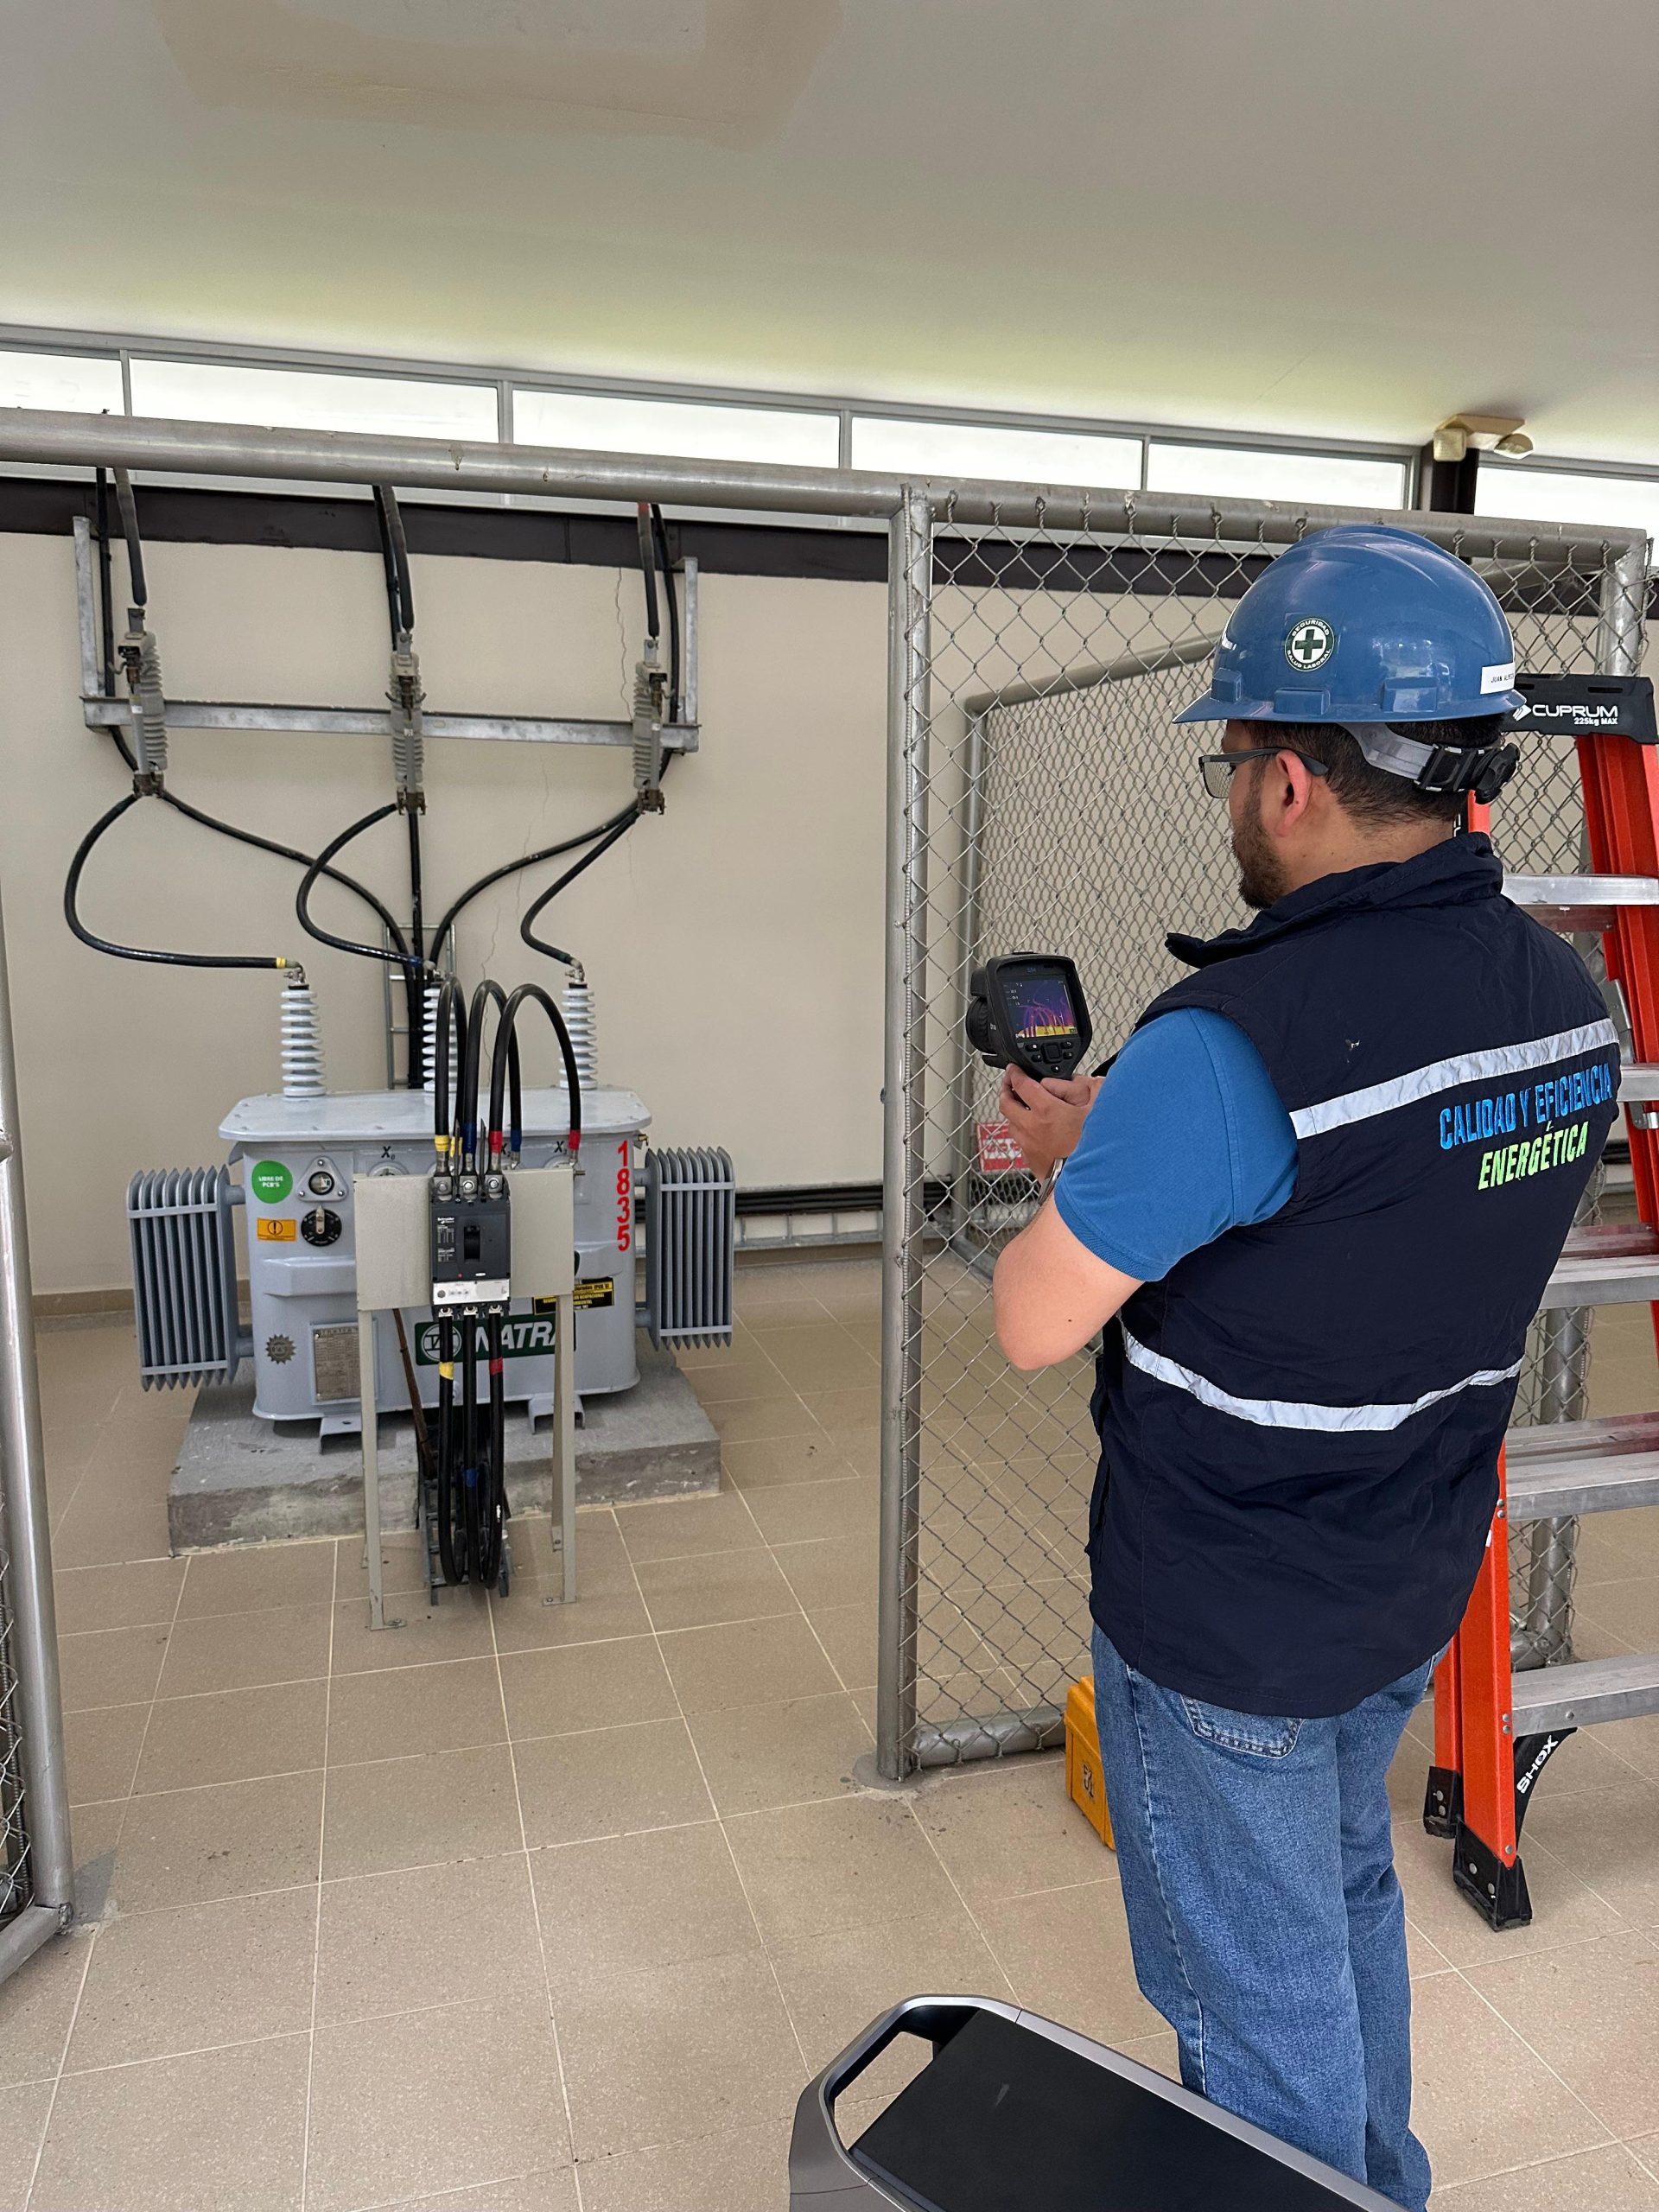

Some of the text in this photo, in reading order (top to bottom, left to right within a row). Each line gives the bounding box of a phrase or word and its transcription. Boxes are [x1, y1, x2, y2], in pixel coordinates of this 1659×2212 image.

[1292, 620, 1330, 637] SEGURIDAD
[1287, 648, 1332, 670] SALUD LABORAL
[1532, 704, 1618, 718] CUPRUM
[1573, 717, 1599, 727] 225kg
[1440, 1063, 1613, 1150] CALIDAD Y EFICIENCIA
[1478, 1121, 1589, 1191] ENERGÉTICA
[1516, 1734, 1559, 1795] SHOX
